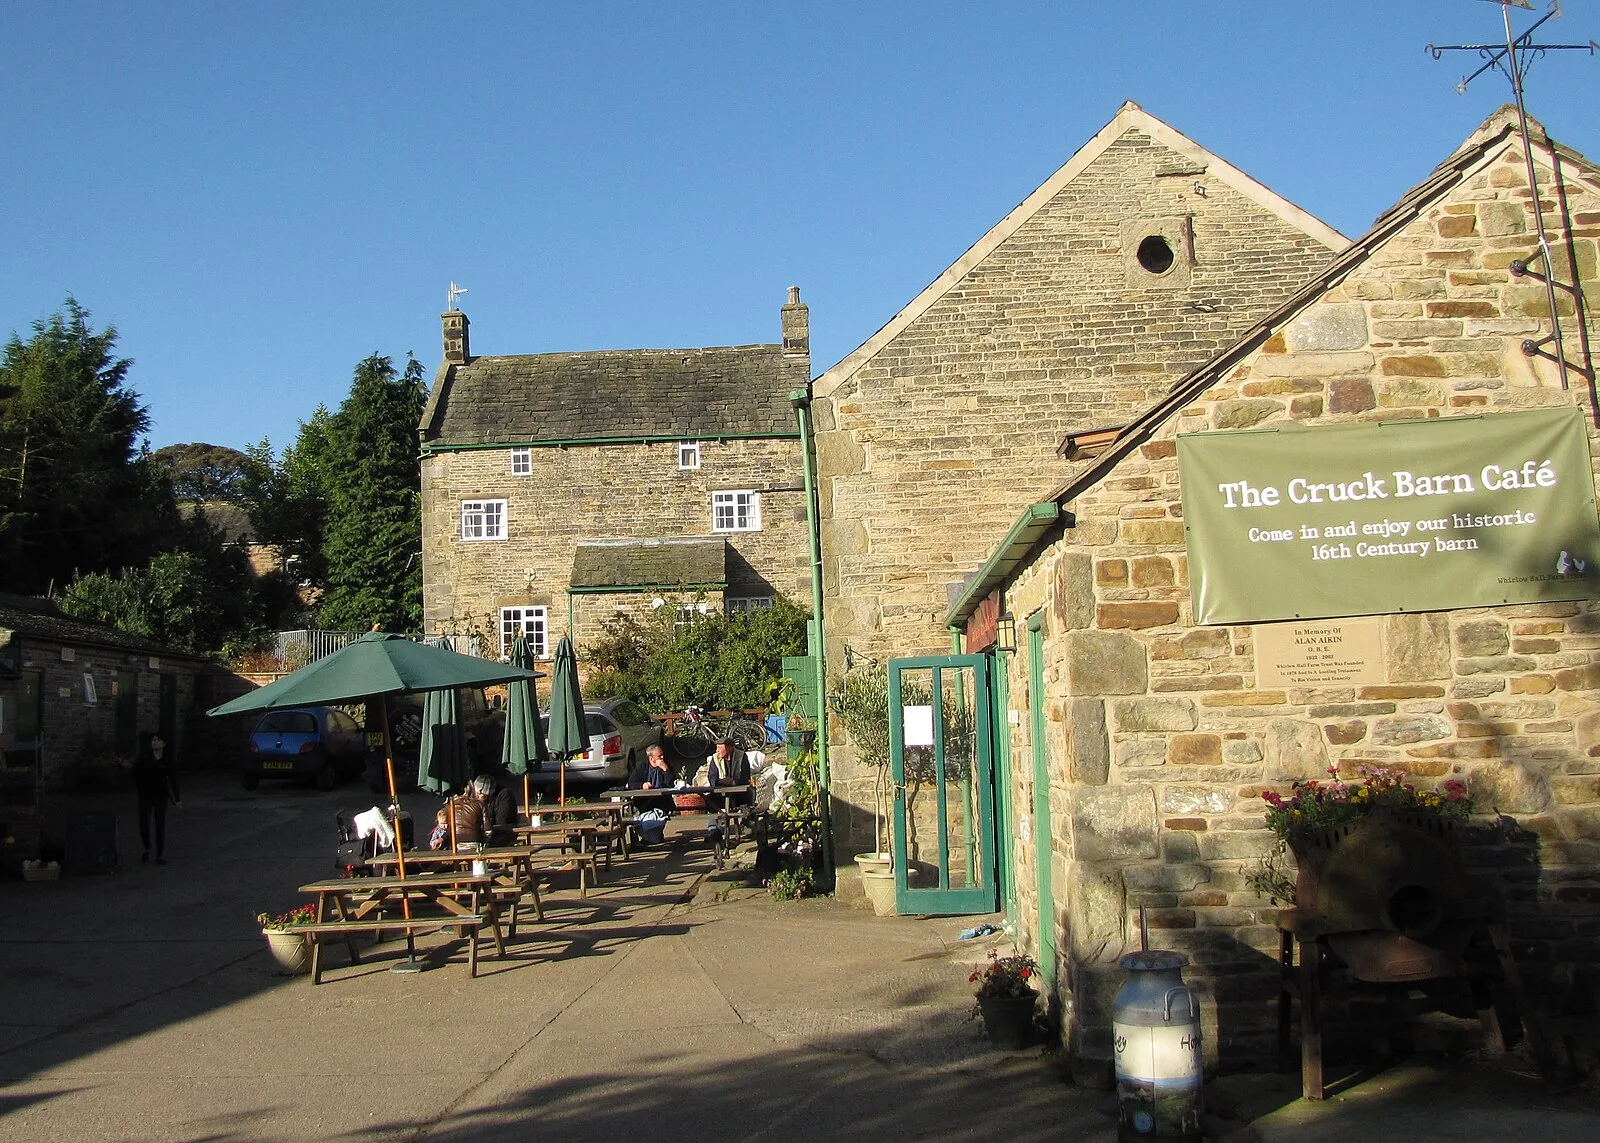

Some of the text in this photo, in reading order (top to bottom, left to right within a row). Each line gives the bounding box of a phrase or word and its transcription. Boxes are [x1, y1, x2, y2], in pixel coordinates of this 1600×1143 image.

[1218, 459, 1556, 508] The Cruck Barn Café
[1248, 509, 1536, 543] Come in and enjoy our historic
[1311, 536, 1479, 561] 16th Century barn
[1294, 636, 1342, 645] ALAN AIKIN
[1303, 628, 1331, 636] Memory
